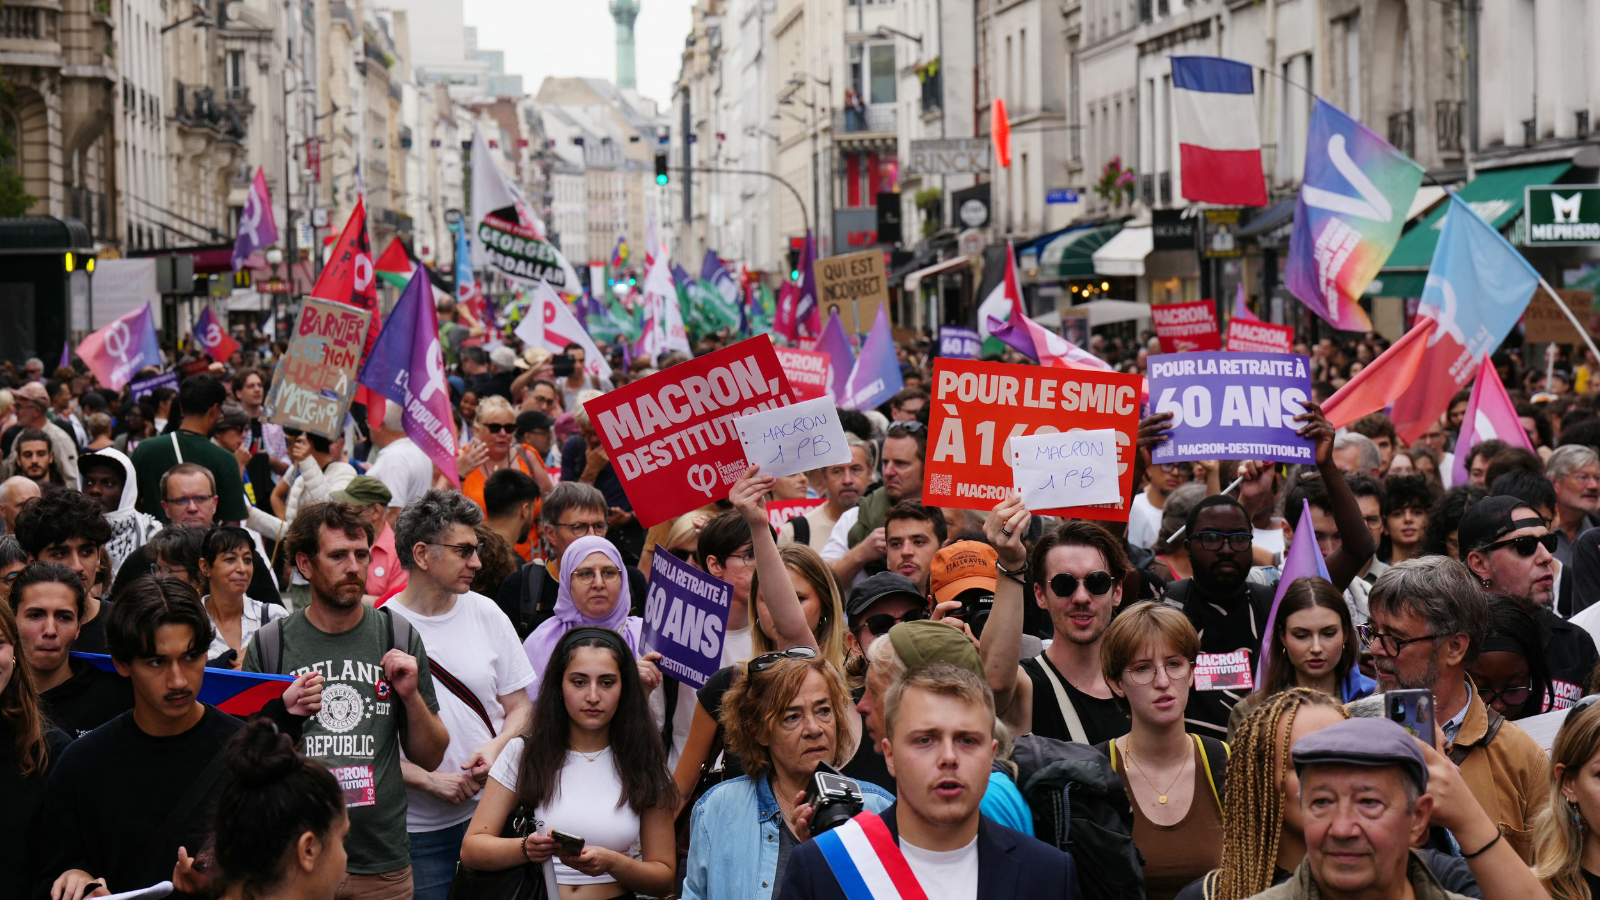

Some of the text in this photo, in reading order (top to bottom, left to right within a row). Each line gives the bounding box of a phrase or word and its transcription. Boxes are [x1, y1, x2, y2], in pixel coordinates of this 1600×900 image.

[914, 150, 983, 172] RINCK
[1532, 223, 1600, 241] MEPHISTO
[479, 225, 555, 263] GEORGES
[850, 257, 874, 277] EST
[1152, 305, 1214, 325] MACRON,
[299, 306, 365, 349] BARNIER
[1229, 321, 1290, 348] MACRON,
[284, 355, 339, 392] LUCIE
[775, 350, 827, 374] ACRON,
[1152, 357, 1307, 379] POUR LA RETRAITE À
[597, 354, 780, 450] MACRON,
[937, 369, 1136, 416] POUR LE SMIC
[275, 377, 339, 434] MATIGNON
[1155, 385, 1310, 431] 60 ANS
[762, 413, 828, 445] MACRON
[932, 403, 967, 464] À
[797, 434, 832, 460] PB
[1034, 440, 1104, 461] MACRON
[1177, 441, 1312, 459] MACRON-DESTITUTION.FR
[715, 460, 723, 469] LA
[717, 458, 747, 479] FRANCE
[1064, 466, 1095, 489] PB
[652, 551, 728, 608] POUR LA RETRAITE À
[644, 580, 723, 659] 60 ANS
[323, 689, 357, 705] AUTHENTIC
[322, 711, 358, 728] COLLECTION
[375, 702, 391, 716] EDT
[305, 734, 375, 757] REPUBLIC
